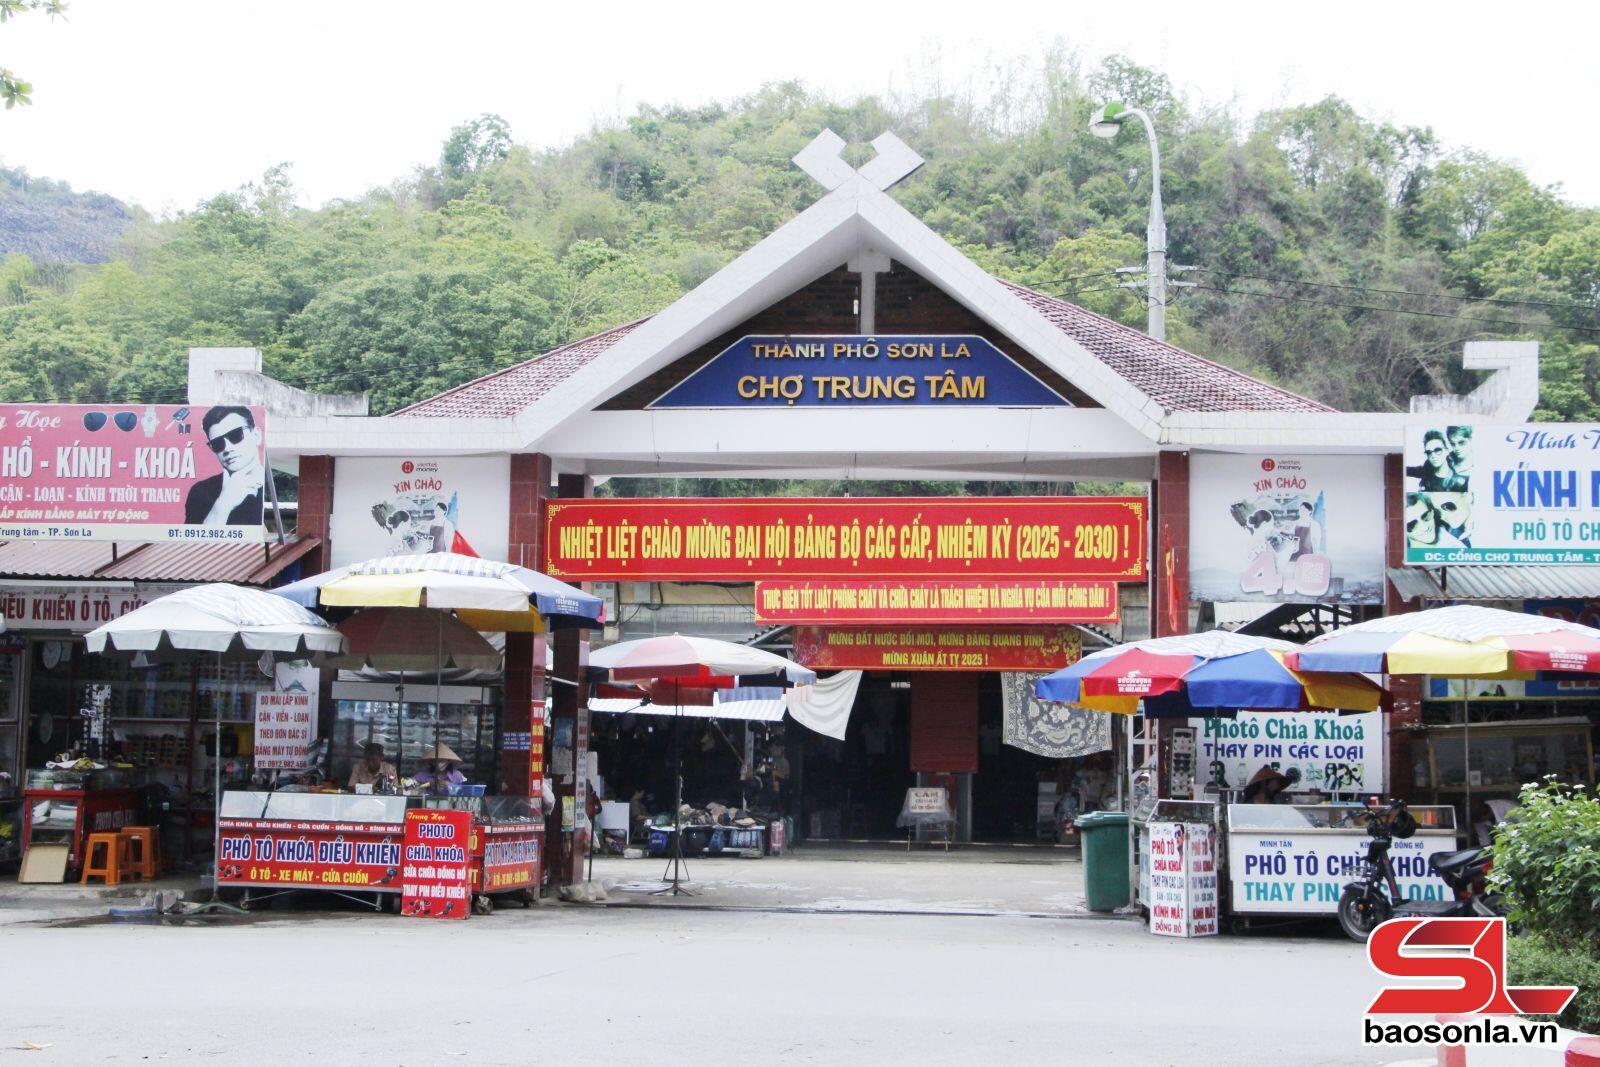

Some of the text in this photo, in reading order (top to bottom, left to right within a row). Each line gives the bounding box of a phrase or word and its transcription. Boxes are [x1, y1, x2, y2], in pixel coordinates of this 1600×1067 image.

[887, 342, 933, 358] SƠN
[941, 343, 971, 358] LA
[737, 369, 985, 404] CHỢ TRUNG TÂM
[57, 440, 112, 479] KÍNH
[135, 441, 196, 479] KHOÁ
[414, 477, 442, 491] CHÀO
[1276, 475, 1306, 490] CHÀO
[1493, 462, 1577, 508] KÍNH
[34, 487, 64, 504] LOẠN
[76, 484, 106, 502] KÍNH
[109, 484, 137, 502] THỜI
[141, 488, 180, 502] TRANG
[168, 529, 243, 539] ĐT: 0912.982.456
[559, 519, 604, 566] NHIỆT
[606, 519, 638, 566] LIỆT
[641, 518, 682, 559] CHÀO
[686, 518, 731, 559] MỪNG
[734, 525, 761, 566] ĐẠI
[765, 518, 790, 566] HỘI
[794, 513, 836, 559] ĐẢNG
[840, 518, 861, 566] BỘ
[865, 518, 896, 559] CÁC
[937, 518, 988, 566] NHIỆM
[992, 518, 1012, 559] KỲ
[1016, 525, 1060, 562] (2025
[1074, 525, 1118, 562] 2030)
[1512, 518, 1547, 541] PHÔ
[1552, 518, 1572, 541] TÔ
[1424, 552, 1445, 561] ĐC:
[1485, 552, 1511, 562] CHỢ
[1512, 552, 1554, 562] TRUNG
[1554, 550, 1583, 562] TÂM
[763, 587, 782, 613] THỰC
[800, 582, 814, 609] TỐT
[814, 585, 832, 613] LUẬT
[833, 584, 857, 609] PHÒNG
[858, 585, 878, 609] CHÁY
[878, 585, 888, 609] VÀ
[910, 585, 928, 609] CHÁY
[930, 585, 939, 609] LÀ
[941, 584, 963, 609] TRÁCH
[965, 584, 988, 613] NHIỆM
[990, 584, 999, 609] VÀ
[1024, 588, 1034, 613] VỤ
[1067, 584, 1088, 609] CÔNG
[1089, 584, 1104, 609] DÂN
[992, 634, 1022, 647] QUANG
[1024, 634, 1045, 646] VINH
[883, 652, 909, 665] MỪNG
[910, 651, 934, 665] XUÂN
[961, 653, 983, 666] 2025
[1265, 716, 1308, 740] Chìa
[1314, 718, 1365, 741] Khoá
[1203, 741, 1364, 763] THAY PIN CÁC LOẠI
[418, 823, 455, 838] PHOTO
[221, 834, 252, 860] PHÔ
[255, 835, 273, 861] TÔ
[276, 835, 315, 863] KHÓA
[318, 834, 352, 864] ĐIỀU
[406, 843, 464, 862] CHÌA KHÓA
[1259, 840, 1278, 848] MINH
[1245, 851, 1286, 876] PHÔ
[1294, 851, 1318, 876] TÔ
[250, 867, 257, 879] Ô
[259, 868, 271, 880] TÔ
[279, 870, 291, 881] XE
[293, 870, 314, 882] MÁY
[343, 868, 368, 884] CUỐN
[1243, 882, 1339, 902] THAY PIN
